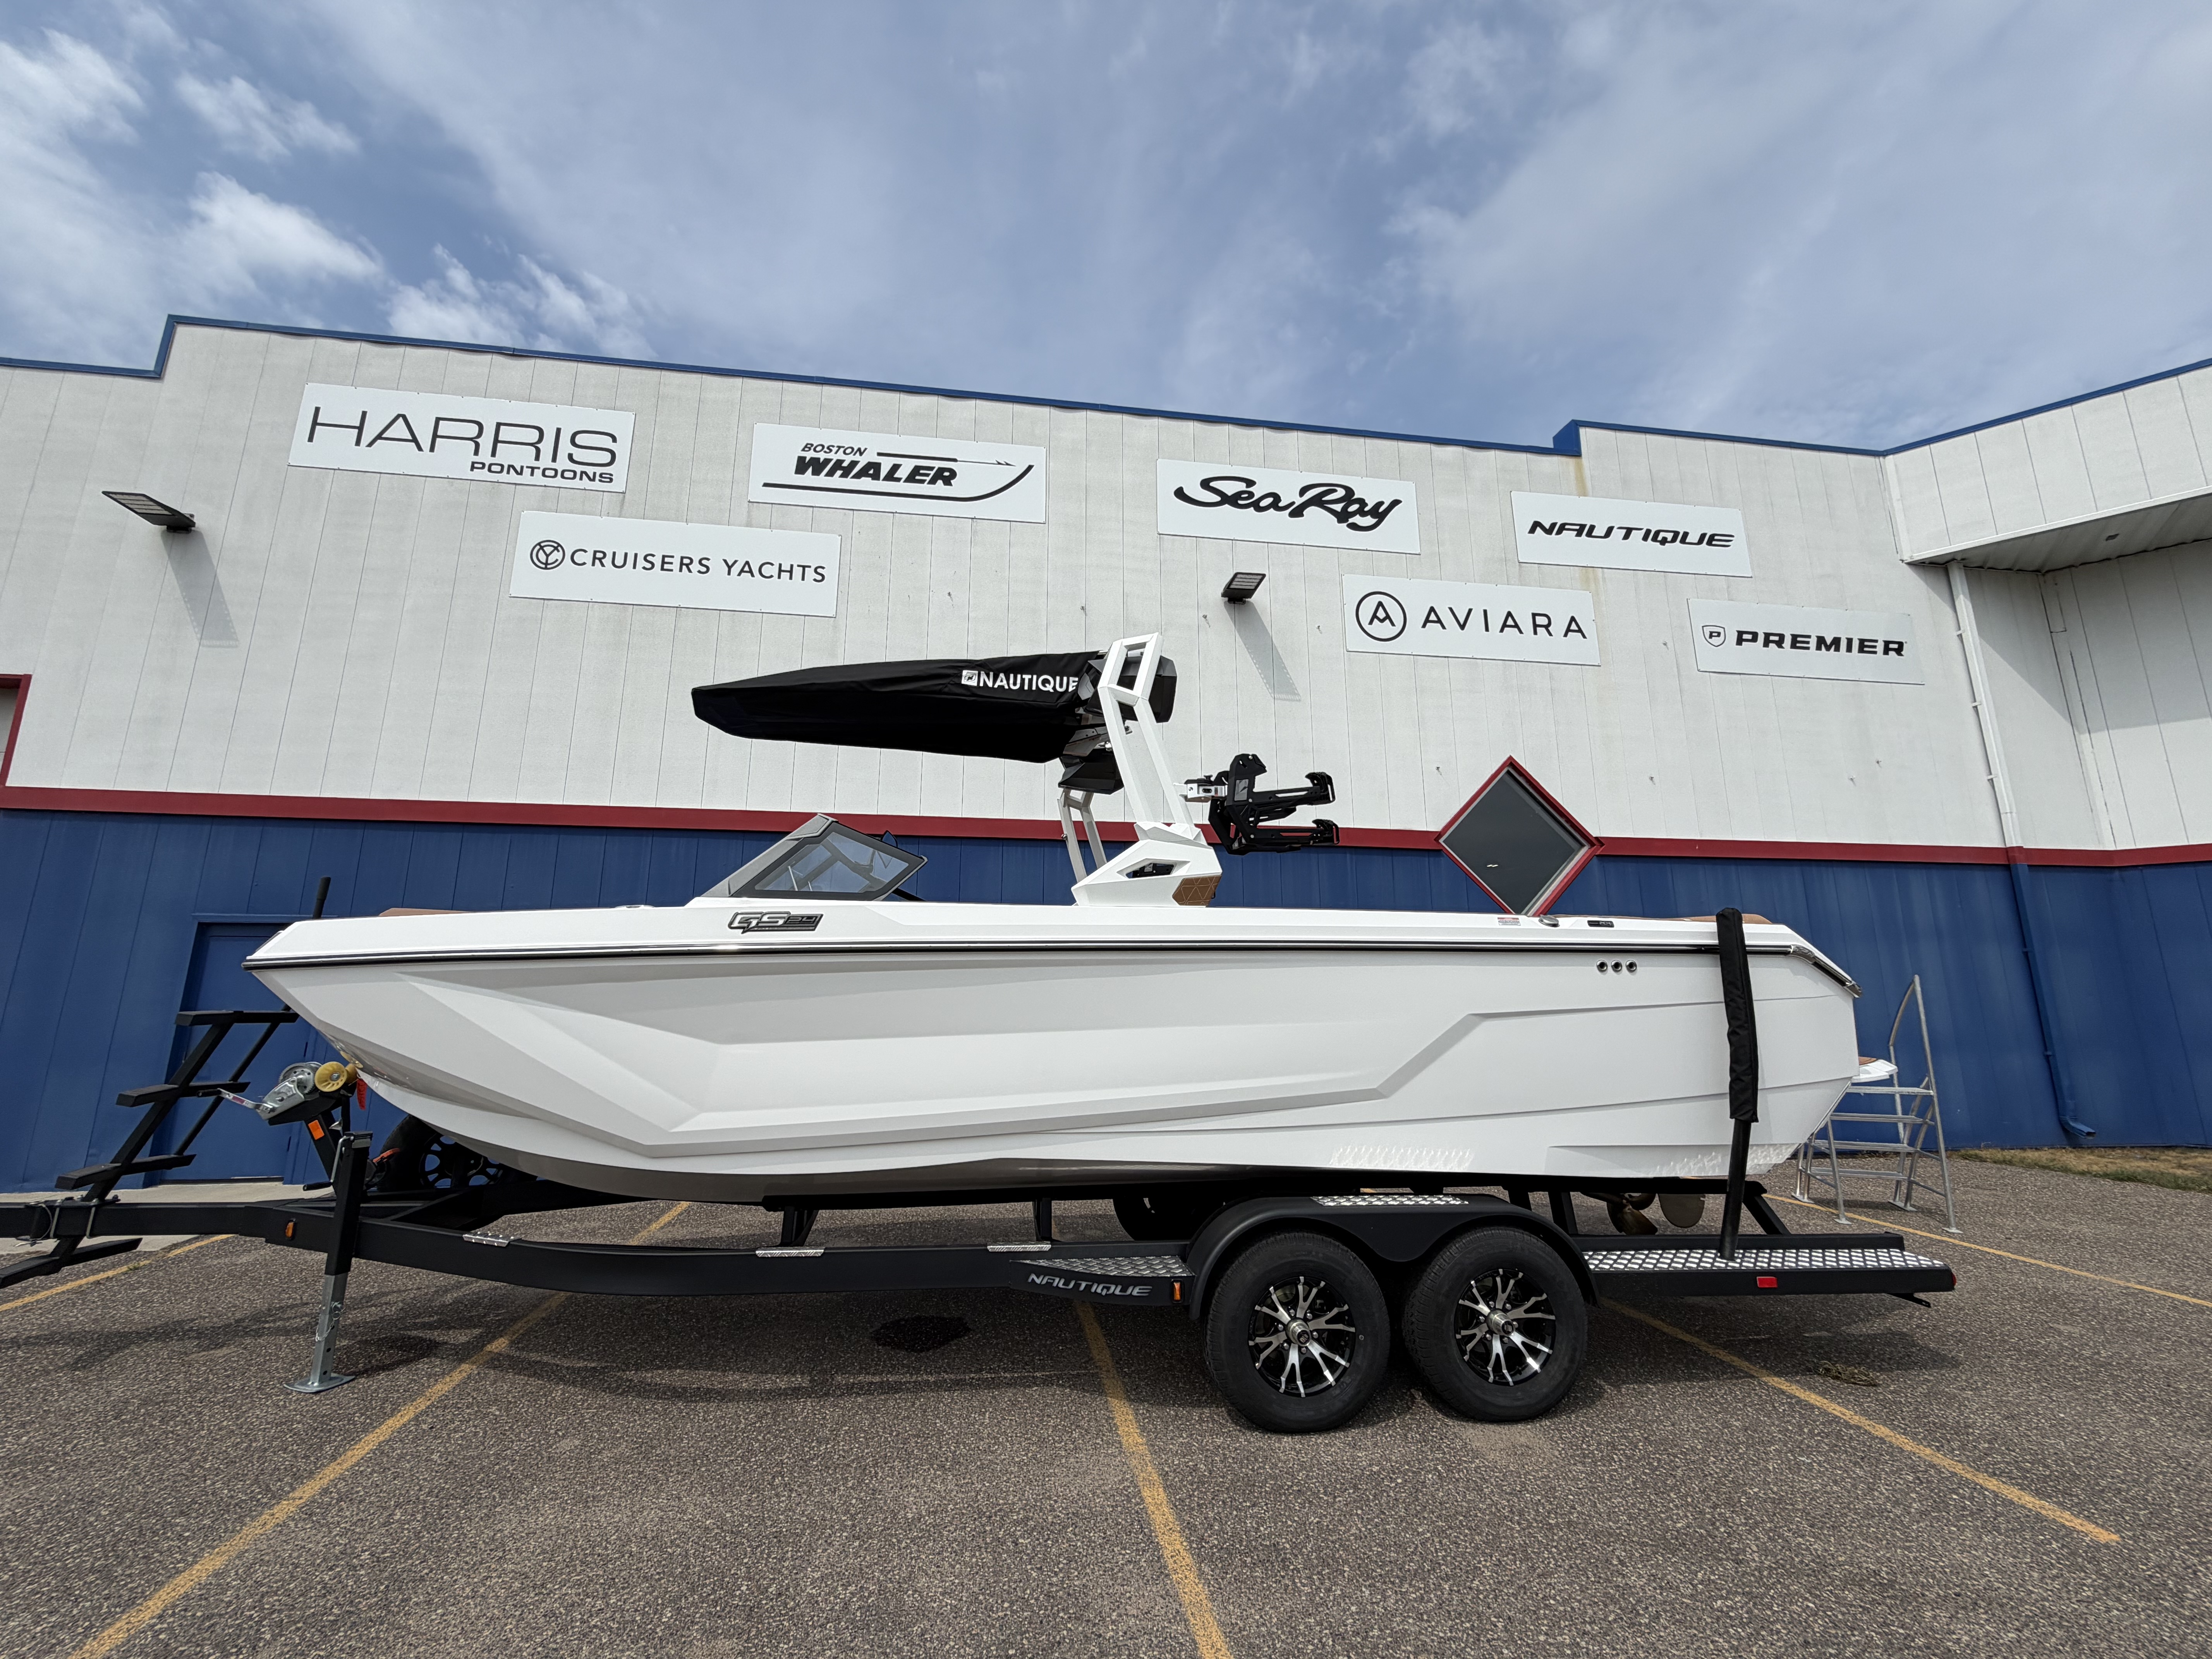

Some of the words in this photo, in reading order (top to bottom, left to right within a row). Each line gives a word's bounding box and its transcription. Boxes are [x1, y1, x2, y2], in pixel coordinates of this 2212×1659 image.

[307, 406, 617, 467] HARRIS
[800, 442, 868, 457] BOSTON
[470, 461, 614, 484] PONTOONS
[794, 455, 958, 487] WHALER
[1173, 476, 1296, 513] Sea
[1288, 483, 1403, 532] Ray
[1527, 520, 1735, 548] NAUTIQUE
[570, 548, 711, 575] CRUISERS
[722, 558, 826, 583] YACHTS
[1421, 606, 1587, 639] AVIARA
[1708, 630, 1721, 639] P
[1735, 630, 1905, 657] PREMIER
[979, 671, 1079, 692] NAUTIQUE
[1027, 1273, 1152, 1296] NAUTIQUE
